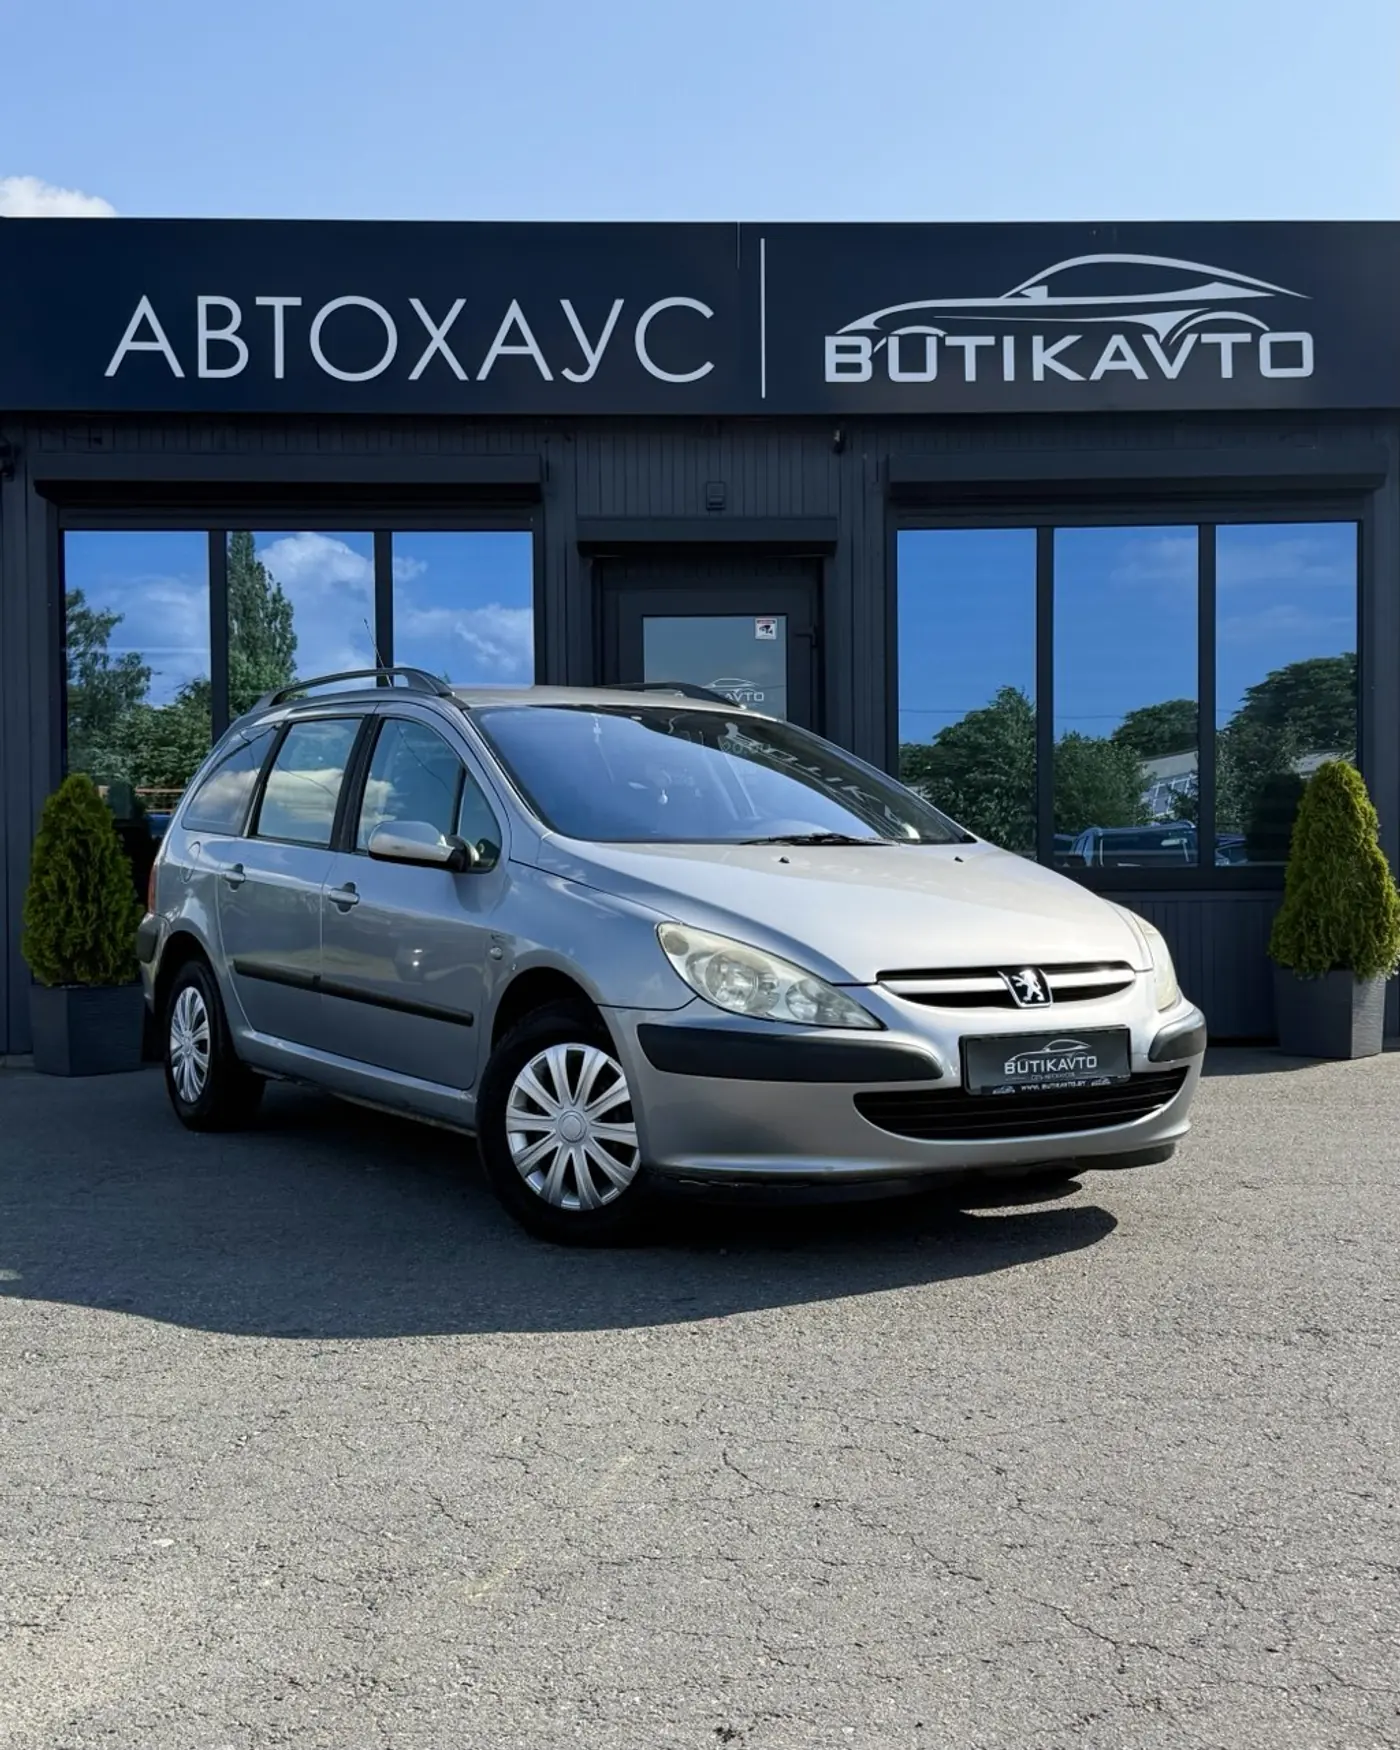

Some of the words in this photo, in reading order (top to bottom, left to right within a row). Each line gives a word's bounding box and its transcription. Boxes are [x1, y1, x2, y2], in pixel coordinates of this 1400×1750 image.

[104, 294, 715, 384] АВТОХАУС
[824, 331, 1315, 383] BUTIKAVTO
[1004, 1056, 1097, 1074] BUTIKAVTO
